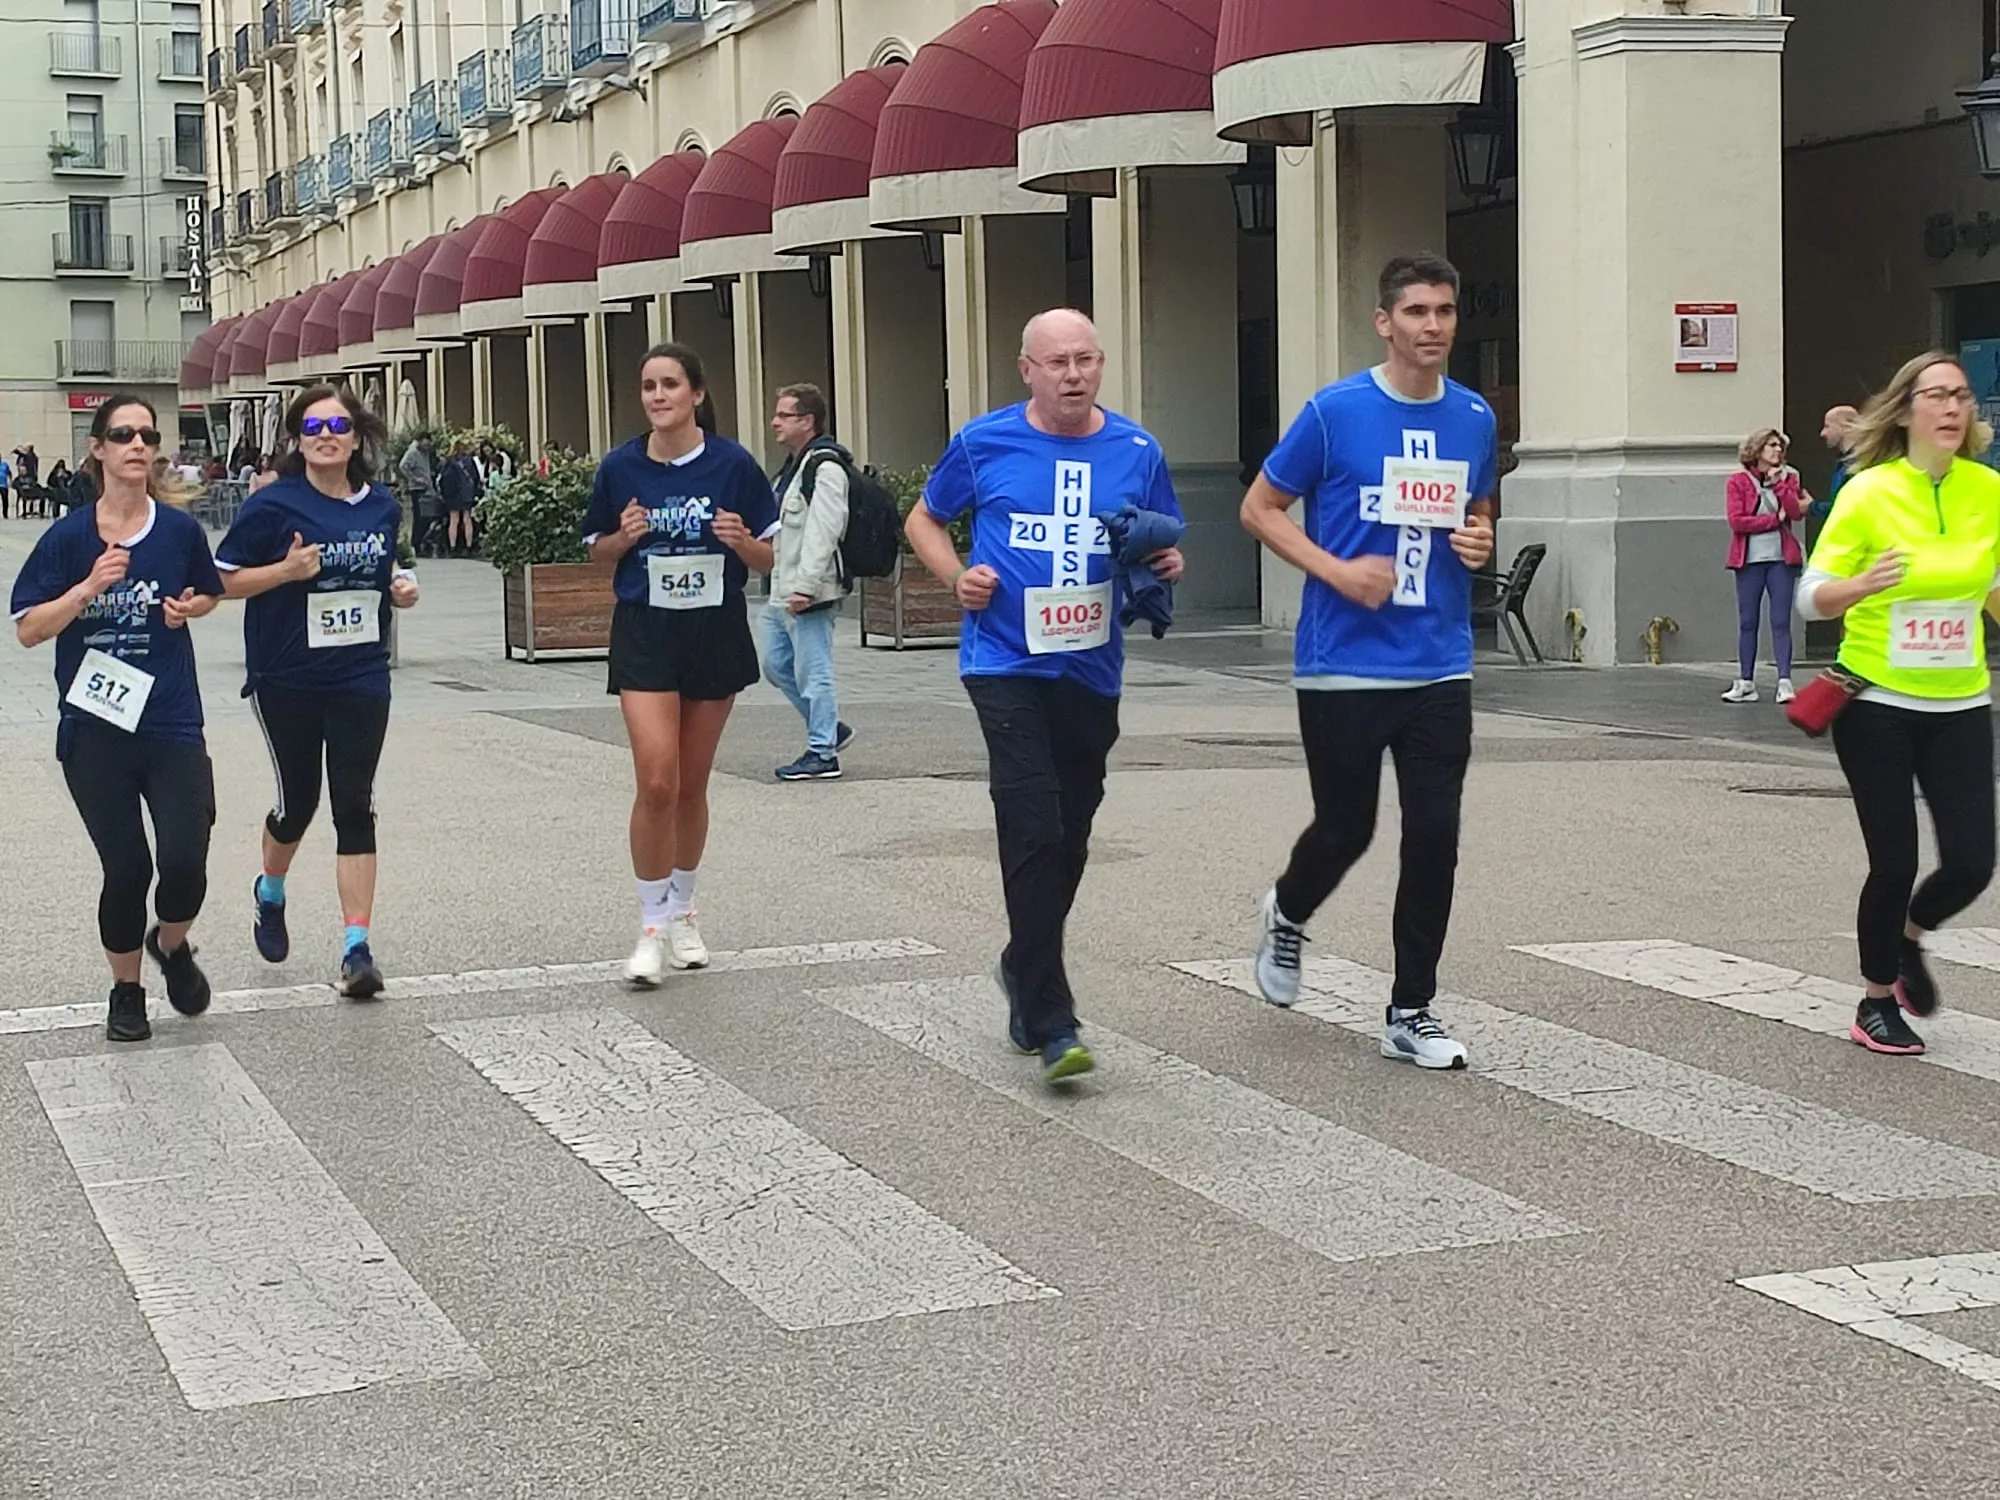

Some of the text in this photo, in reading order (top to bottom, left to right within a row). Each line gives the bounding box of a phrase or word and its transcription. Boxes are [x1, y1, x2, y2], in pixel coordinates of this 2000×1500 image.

[186, 195, 202, 293] HOSTAL
[1396, 481, 1457, 503] 1002
[1016, 522, 1046, 541] 20
[661, 571, 706, 591] 543
[321, 607, 362, 628] 515
[1040, 602, 1102, 626] 1003
[1904, 619, 1965, 639] 1104
[87, 672, 130, 703] 517
